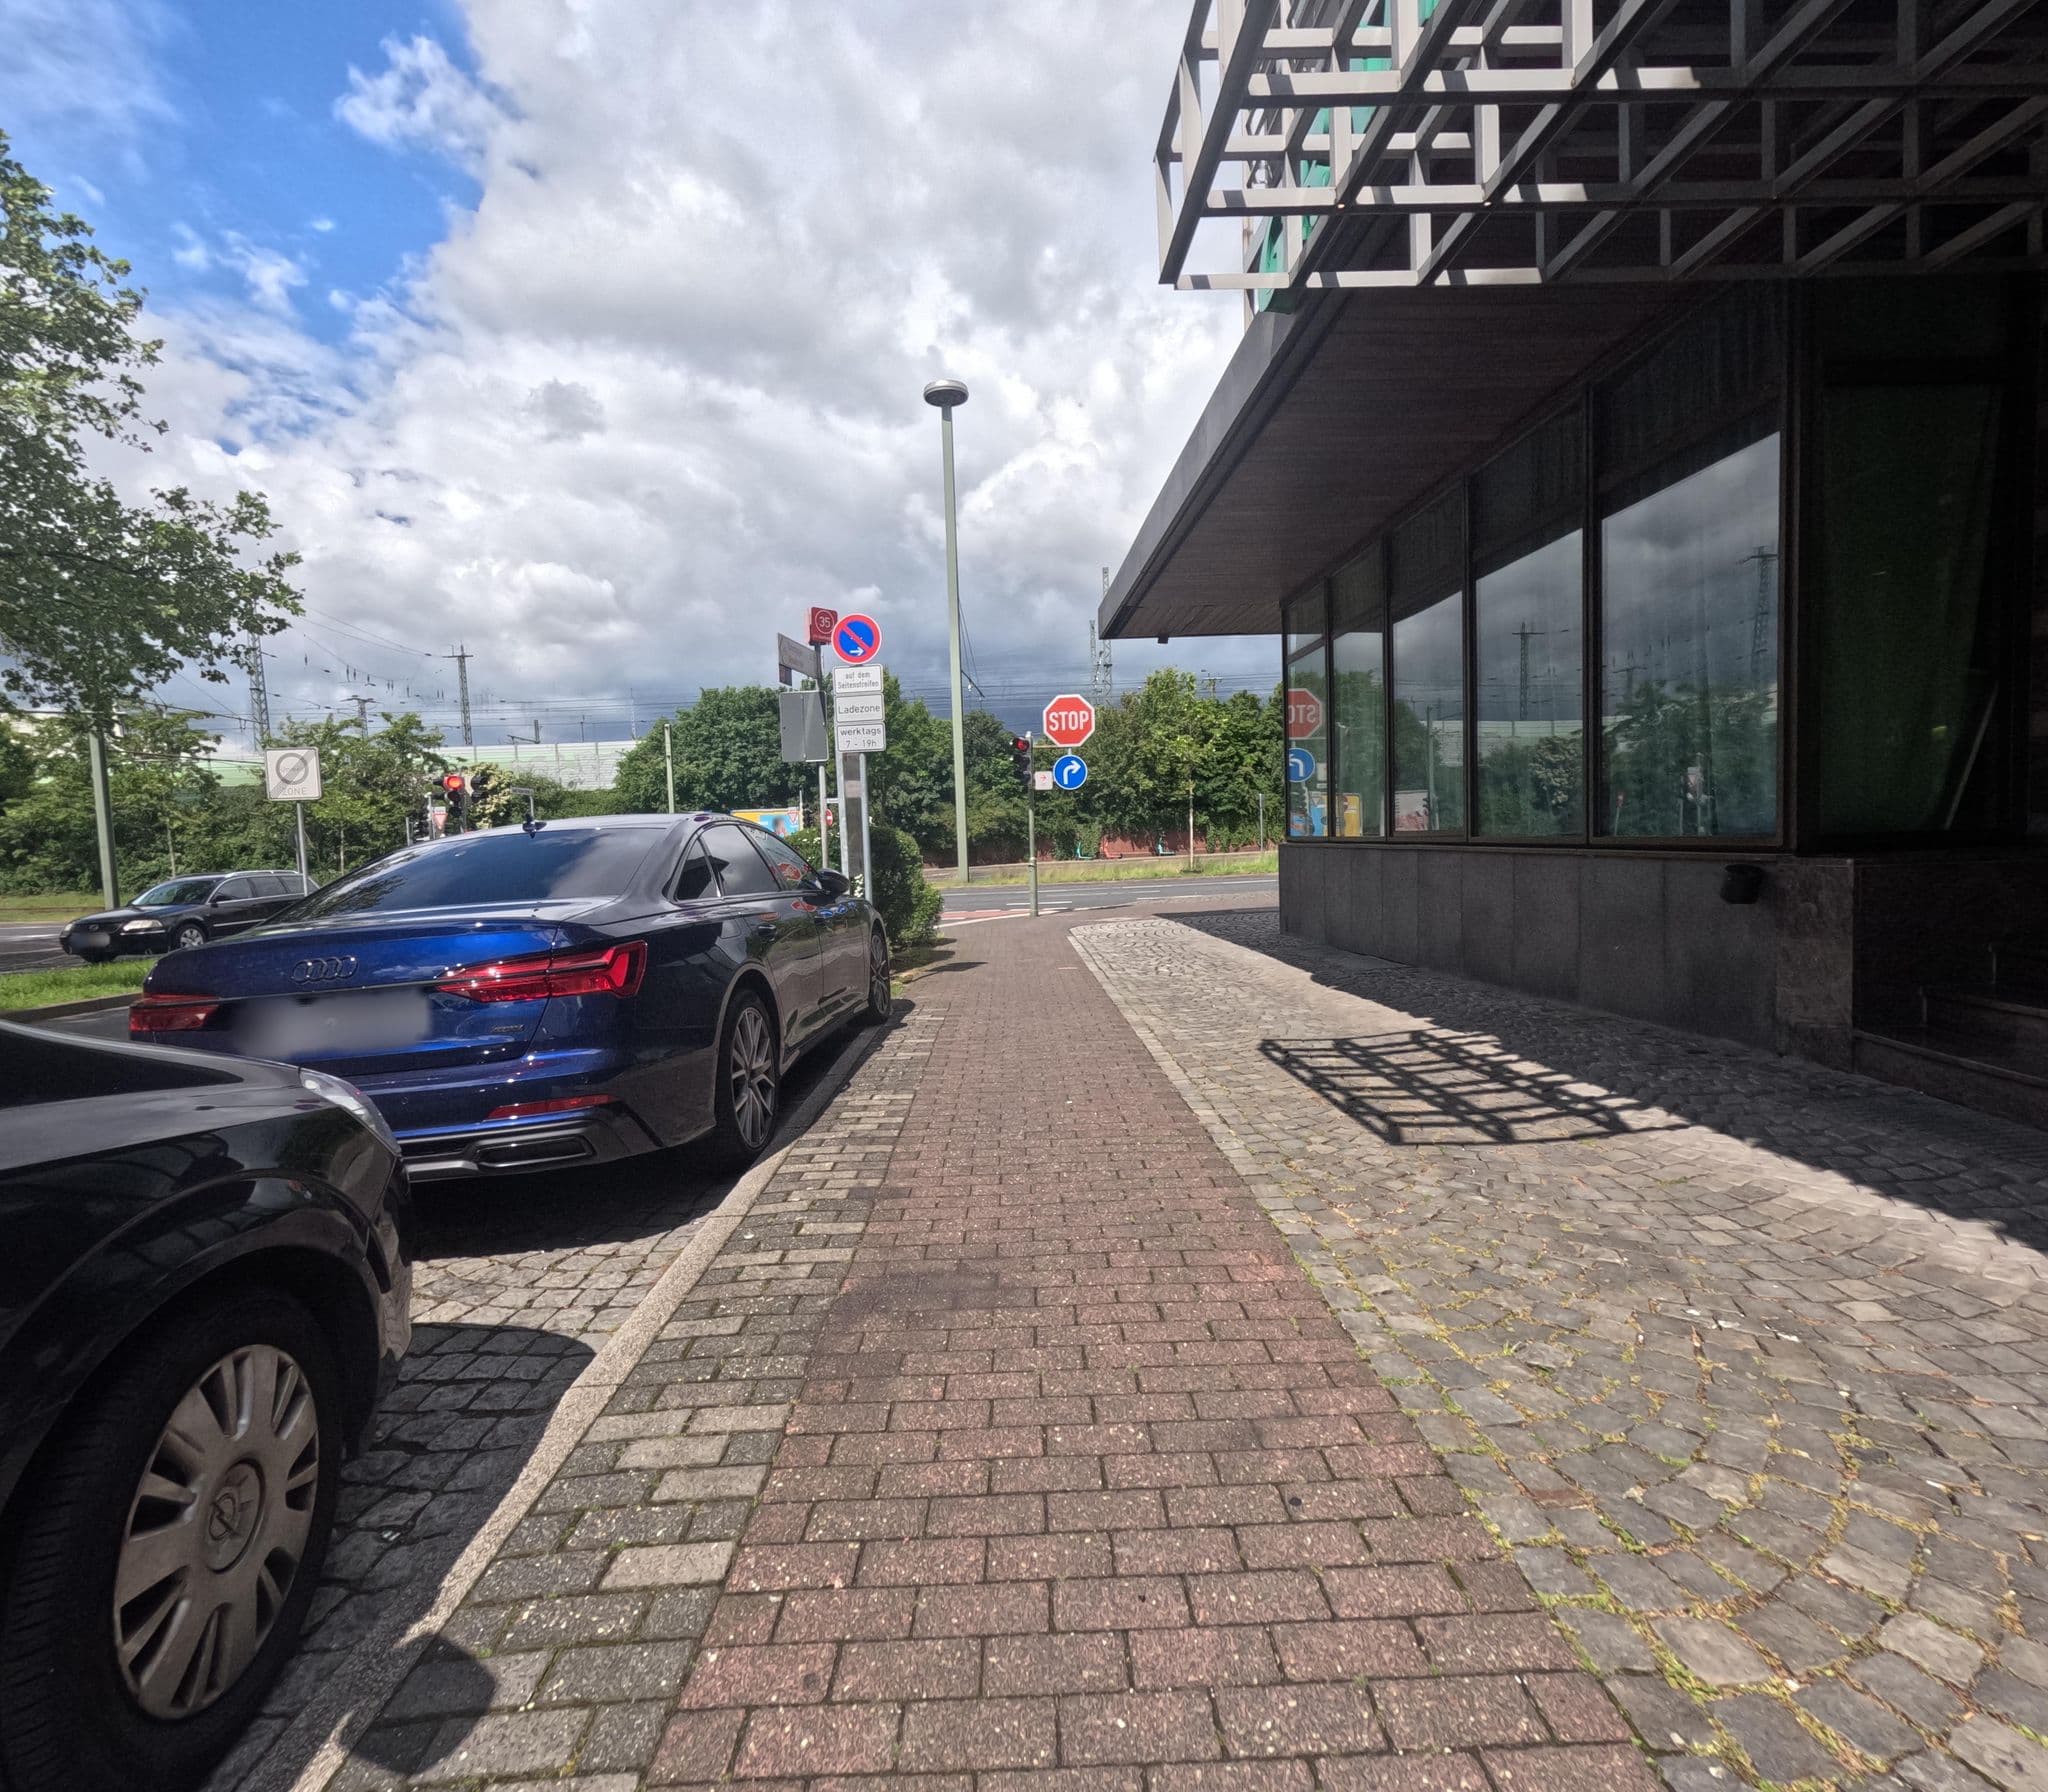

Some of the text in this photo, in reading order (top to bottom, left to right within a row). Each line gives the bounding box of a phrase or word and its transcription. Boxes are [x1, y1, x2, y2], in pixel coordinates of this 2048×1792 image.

[819, 616, 831, 628] 35
[838, 680, 879, 690] Seitenstreifen
[838, 705, 881, 714] Ladezone
[1049, 711, 1090, 731] STOP
[840, 727, 882, 737] werktags
[846, 740, 851, 748] 7
[862, 739, 877, 747] 19h
